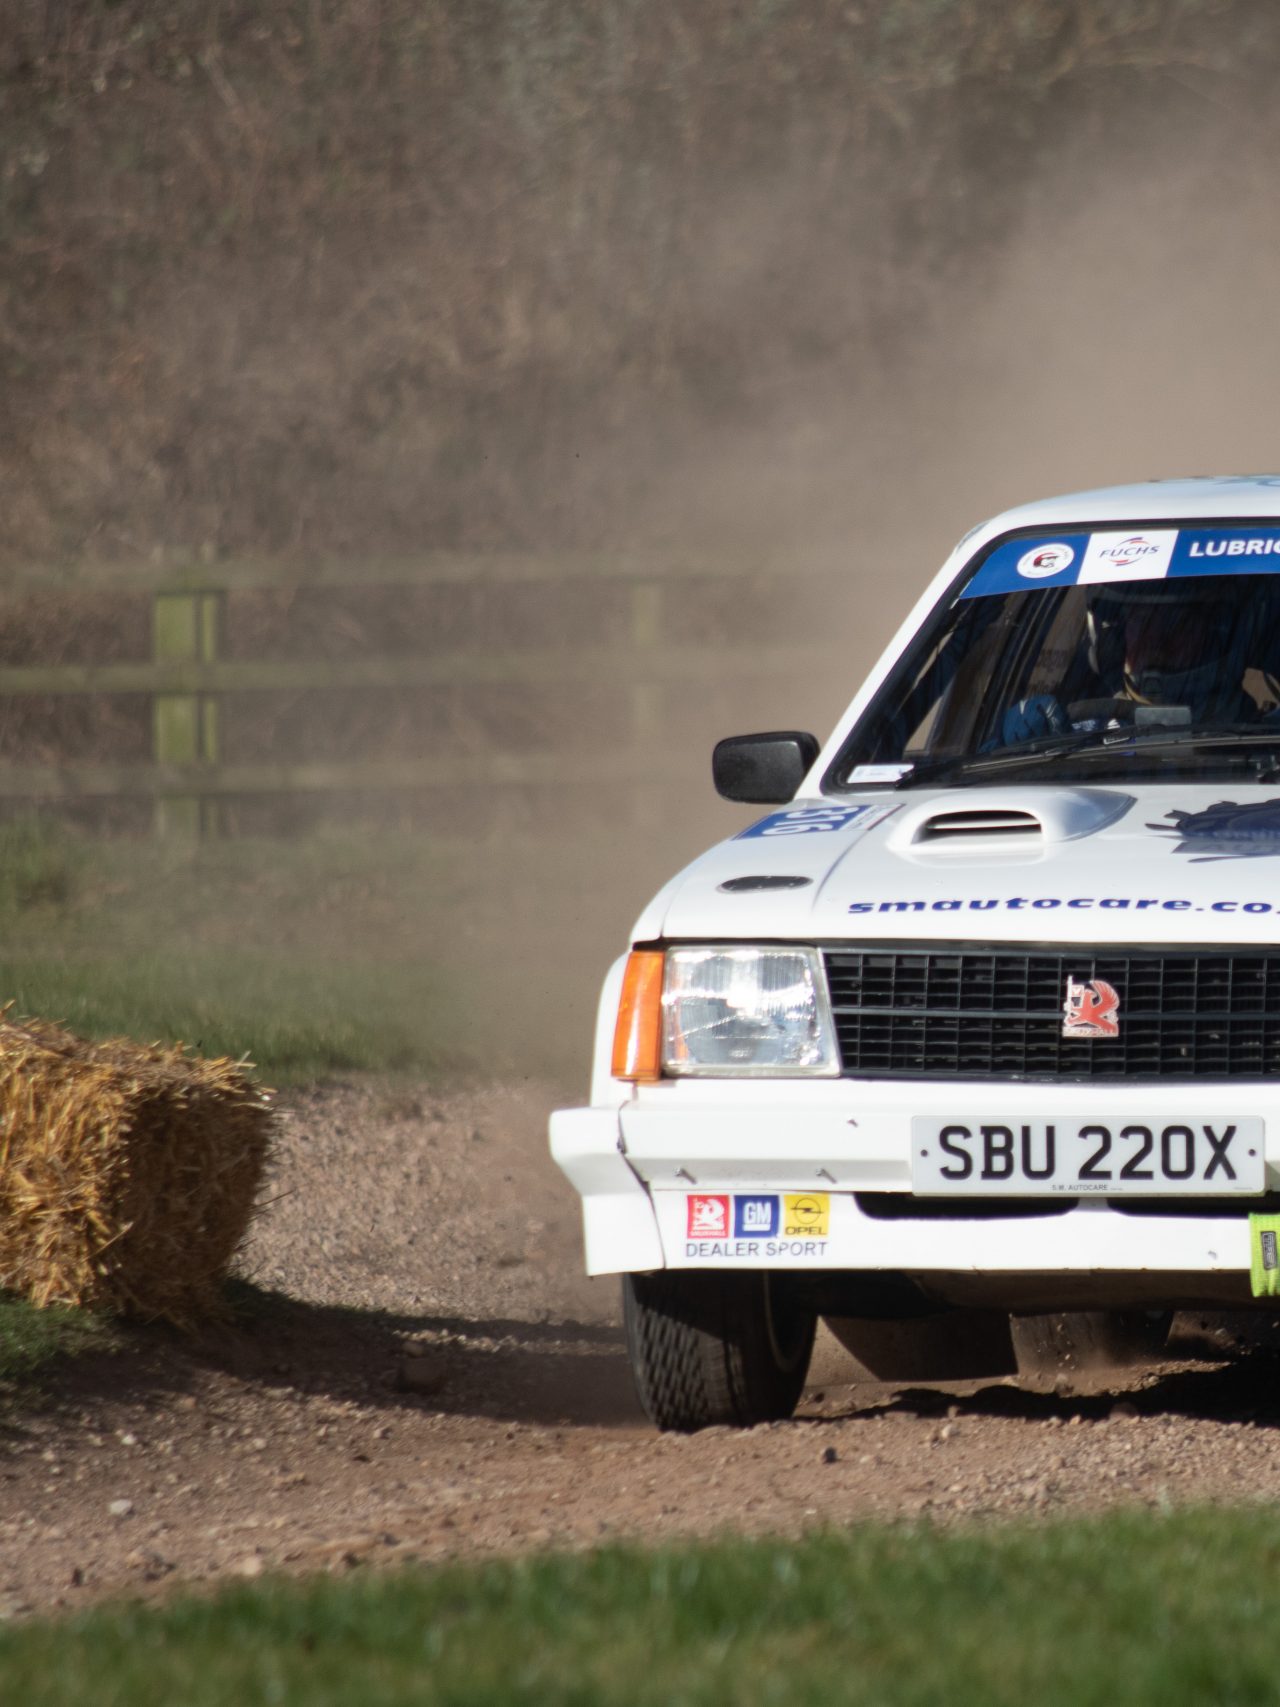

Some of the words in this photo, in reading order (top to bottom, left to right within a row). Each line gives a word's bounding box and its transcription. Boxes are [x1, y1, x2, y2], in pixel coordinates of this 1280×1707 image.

[1099, 545, 1160, 558] FUCHS
[761, 805, 860, 836] 316
[938, 1125, 1056, 1181] SBU
[1077, 1125, 1238, 1181] 220X
[742, 1201, 772, 1225] GM
[784, 1226, 828, 1236] OPEL
[686, 1243, 760, 1257] DEALER
[765, 1242, 828, 1257] SPORT
